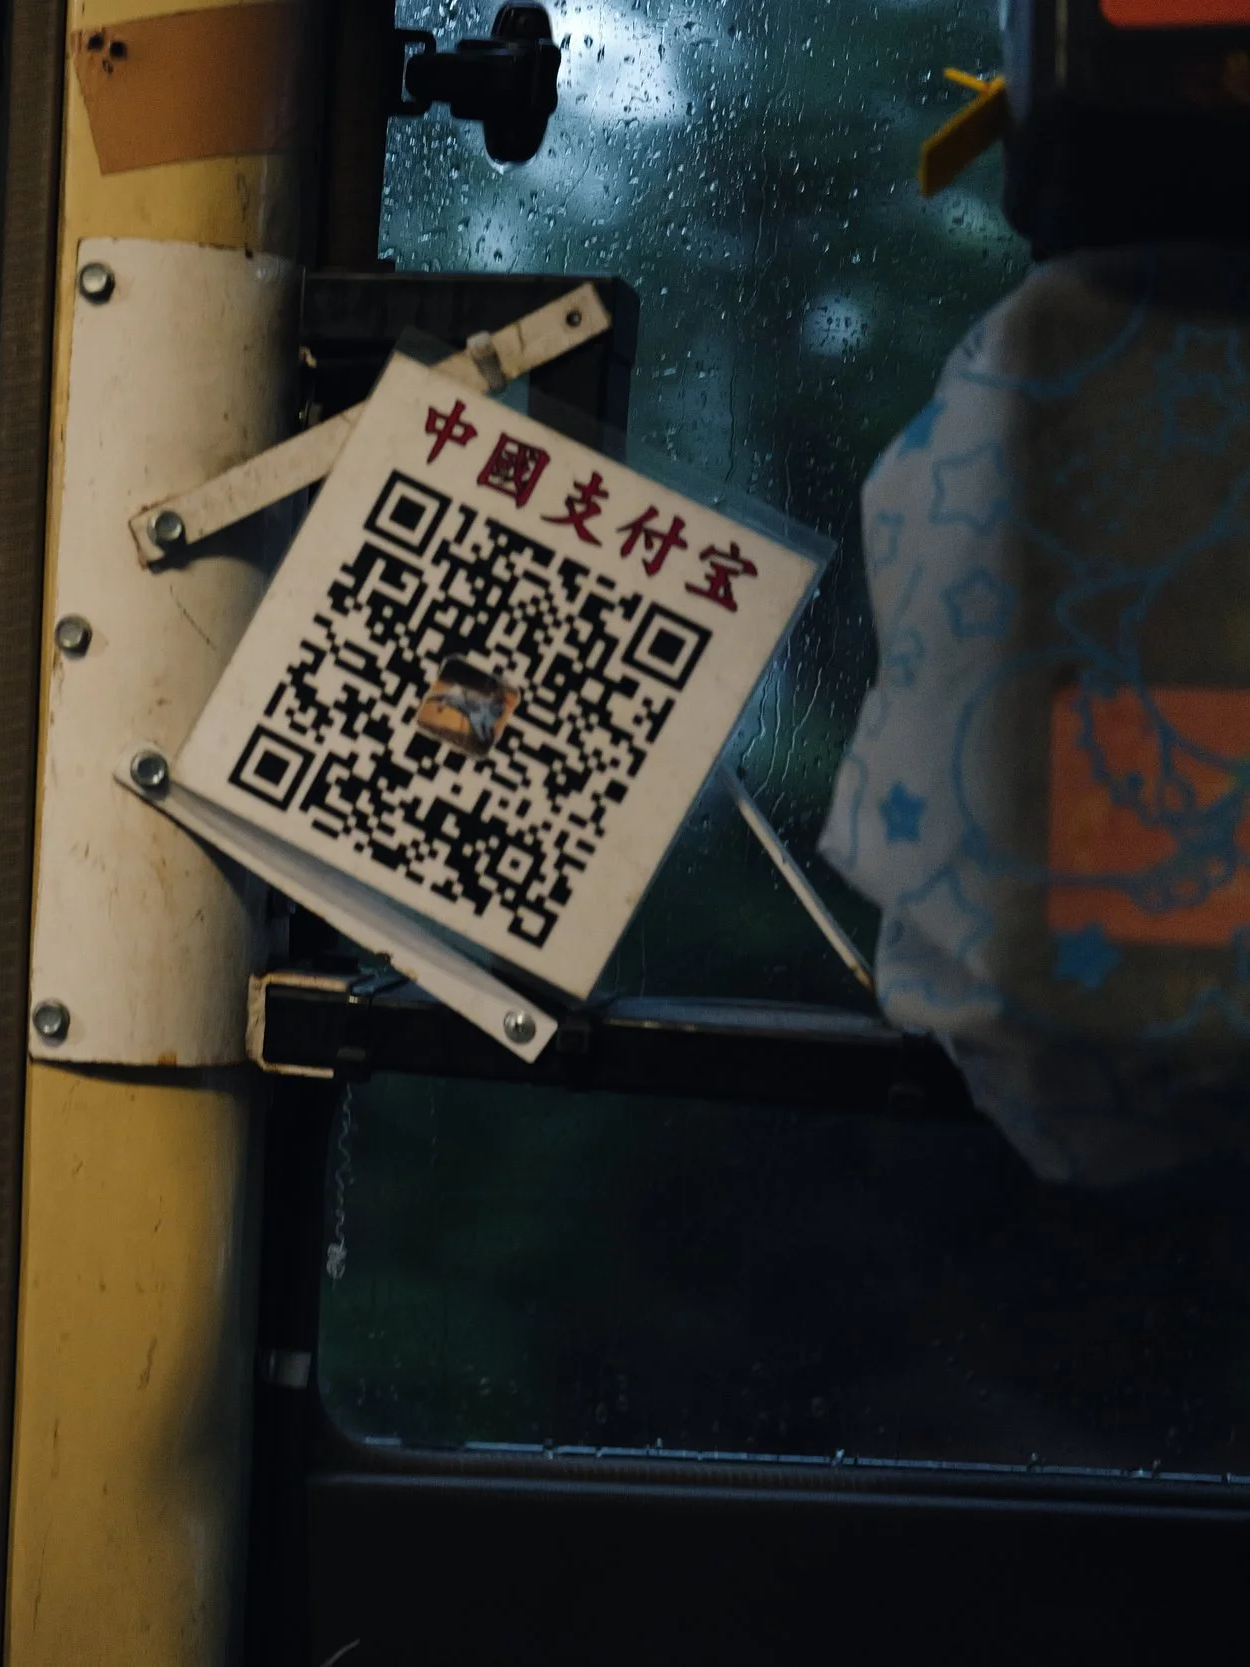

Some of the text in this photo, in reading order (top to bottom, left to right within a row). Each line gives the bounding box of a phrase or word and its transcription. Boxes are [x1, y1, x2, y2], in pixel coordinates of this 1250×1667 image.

[424, 400, 758, 613] 中國支付宝
